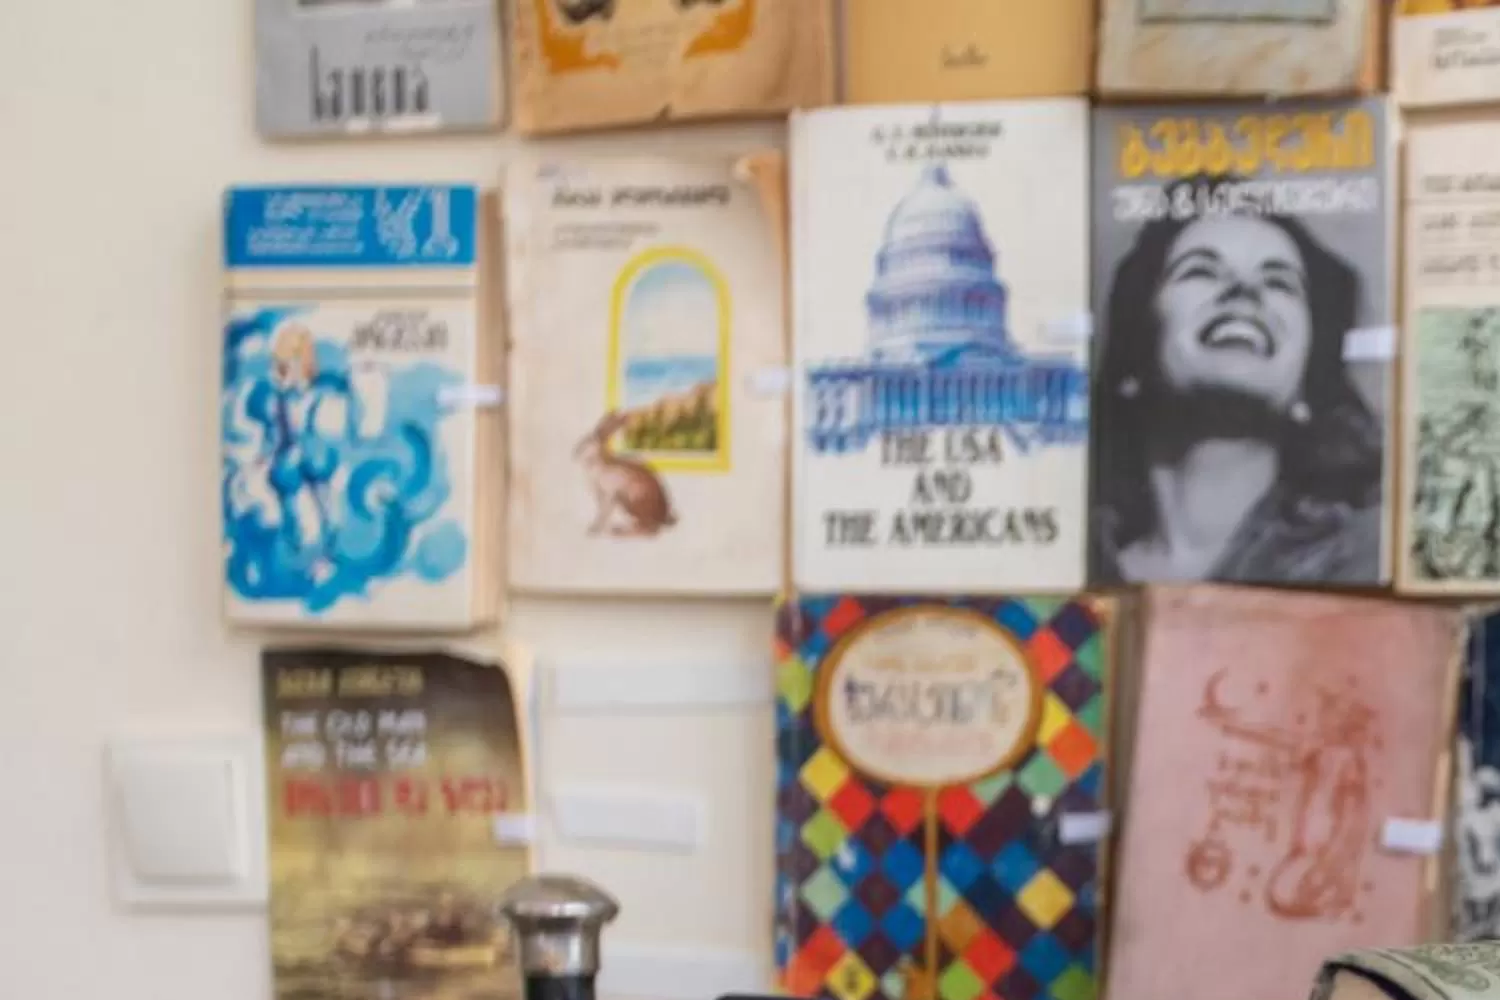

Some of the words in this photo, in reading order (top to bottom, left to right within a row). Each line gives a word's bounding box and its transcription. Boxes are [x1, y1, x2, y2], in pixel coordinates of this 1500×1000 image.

[881, 429, 930, 464] THE
[944, 427, 1005, 463] USA
[912, 470, 973, 503] AND
[825, 509, 877, 546] THE
[889, 507, 1060, 543] AMERICANS
